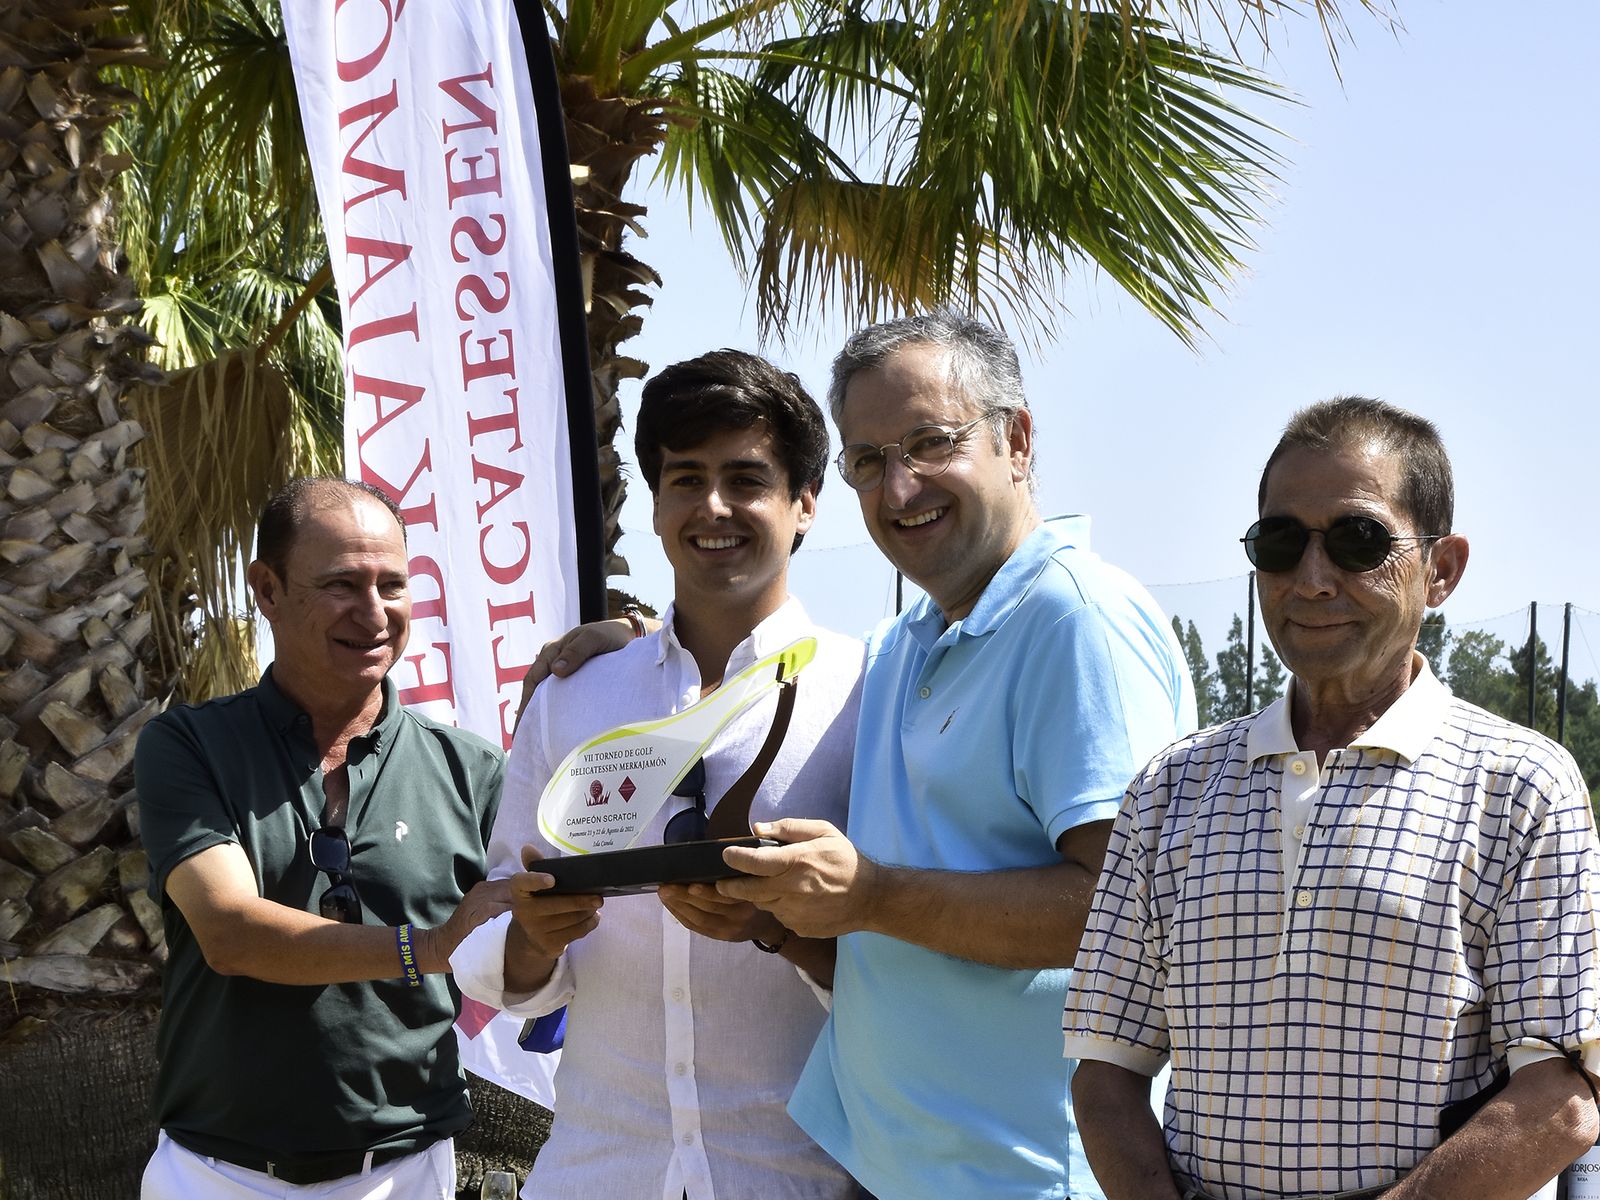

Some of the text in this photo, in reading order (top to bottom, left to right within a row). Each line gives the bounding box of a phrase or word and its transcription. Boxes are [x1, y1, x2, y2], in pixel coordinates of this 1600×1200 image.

[584, 746, 653, 762] VII TORNEO DE GOLF
[570, 757, 667, 777] DELICATESSEN MERKAJAMÓN
[566, 812, 637, 826] CAMPEÓN SCRATCH
[568, 831, 587, 839] Ayamonte
